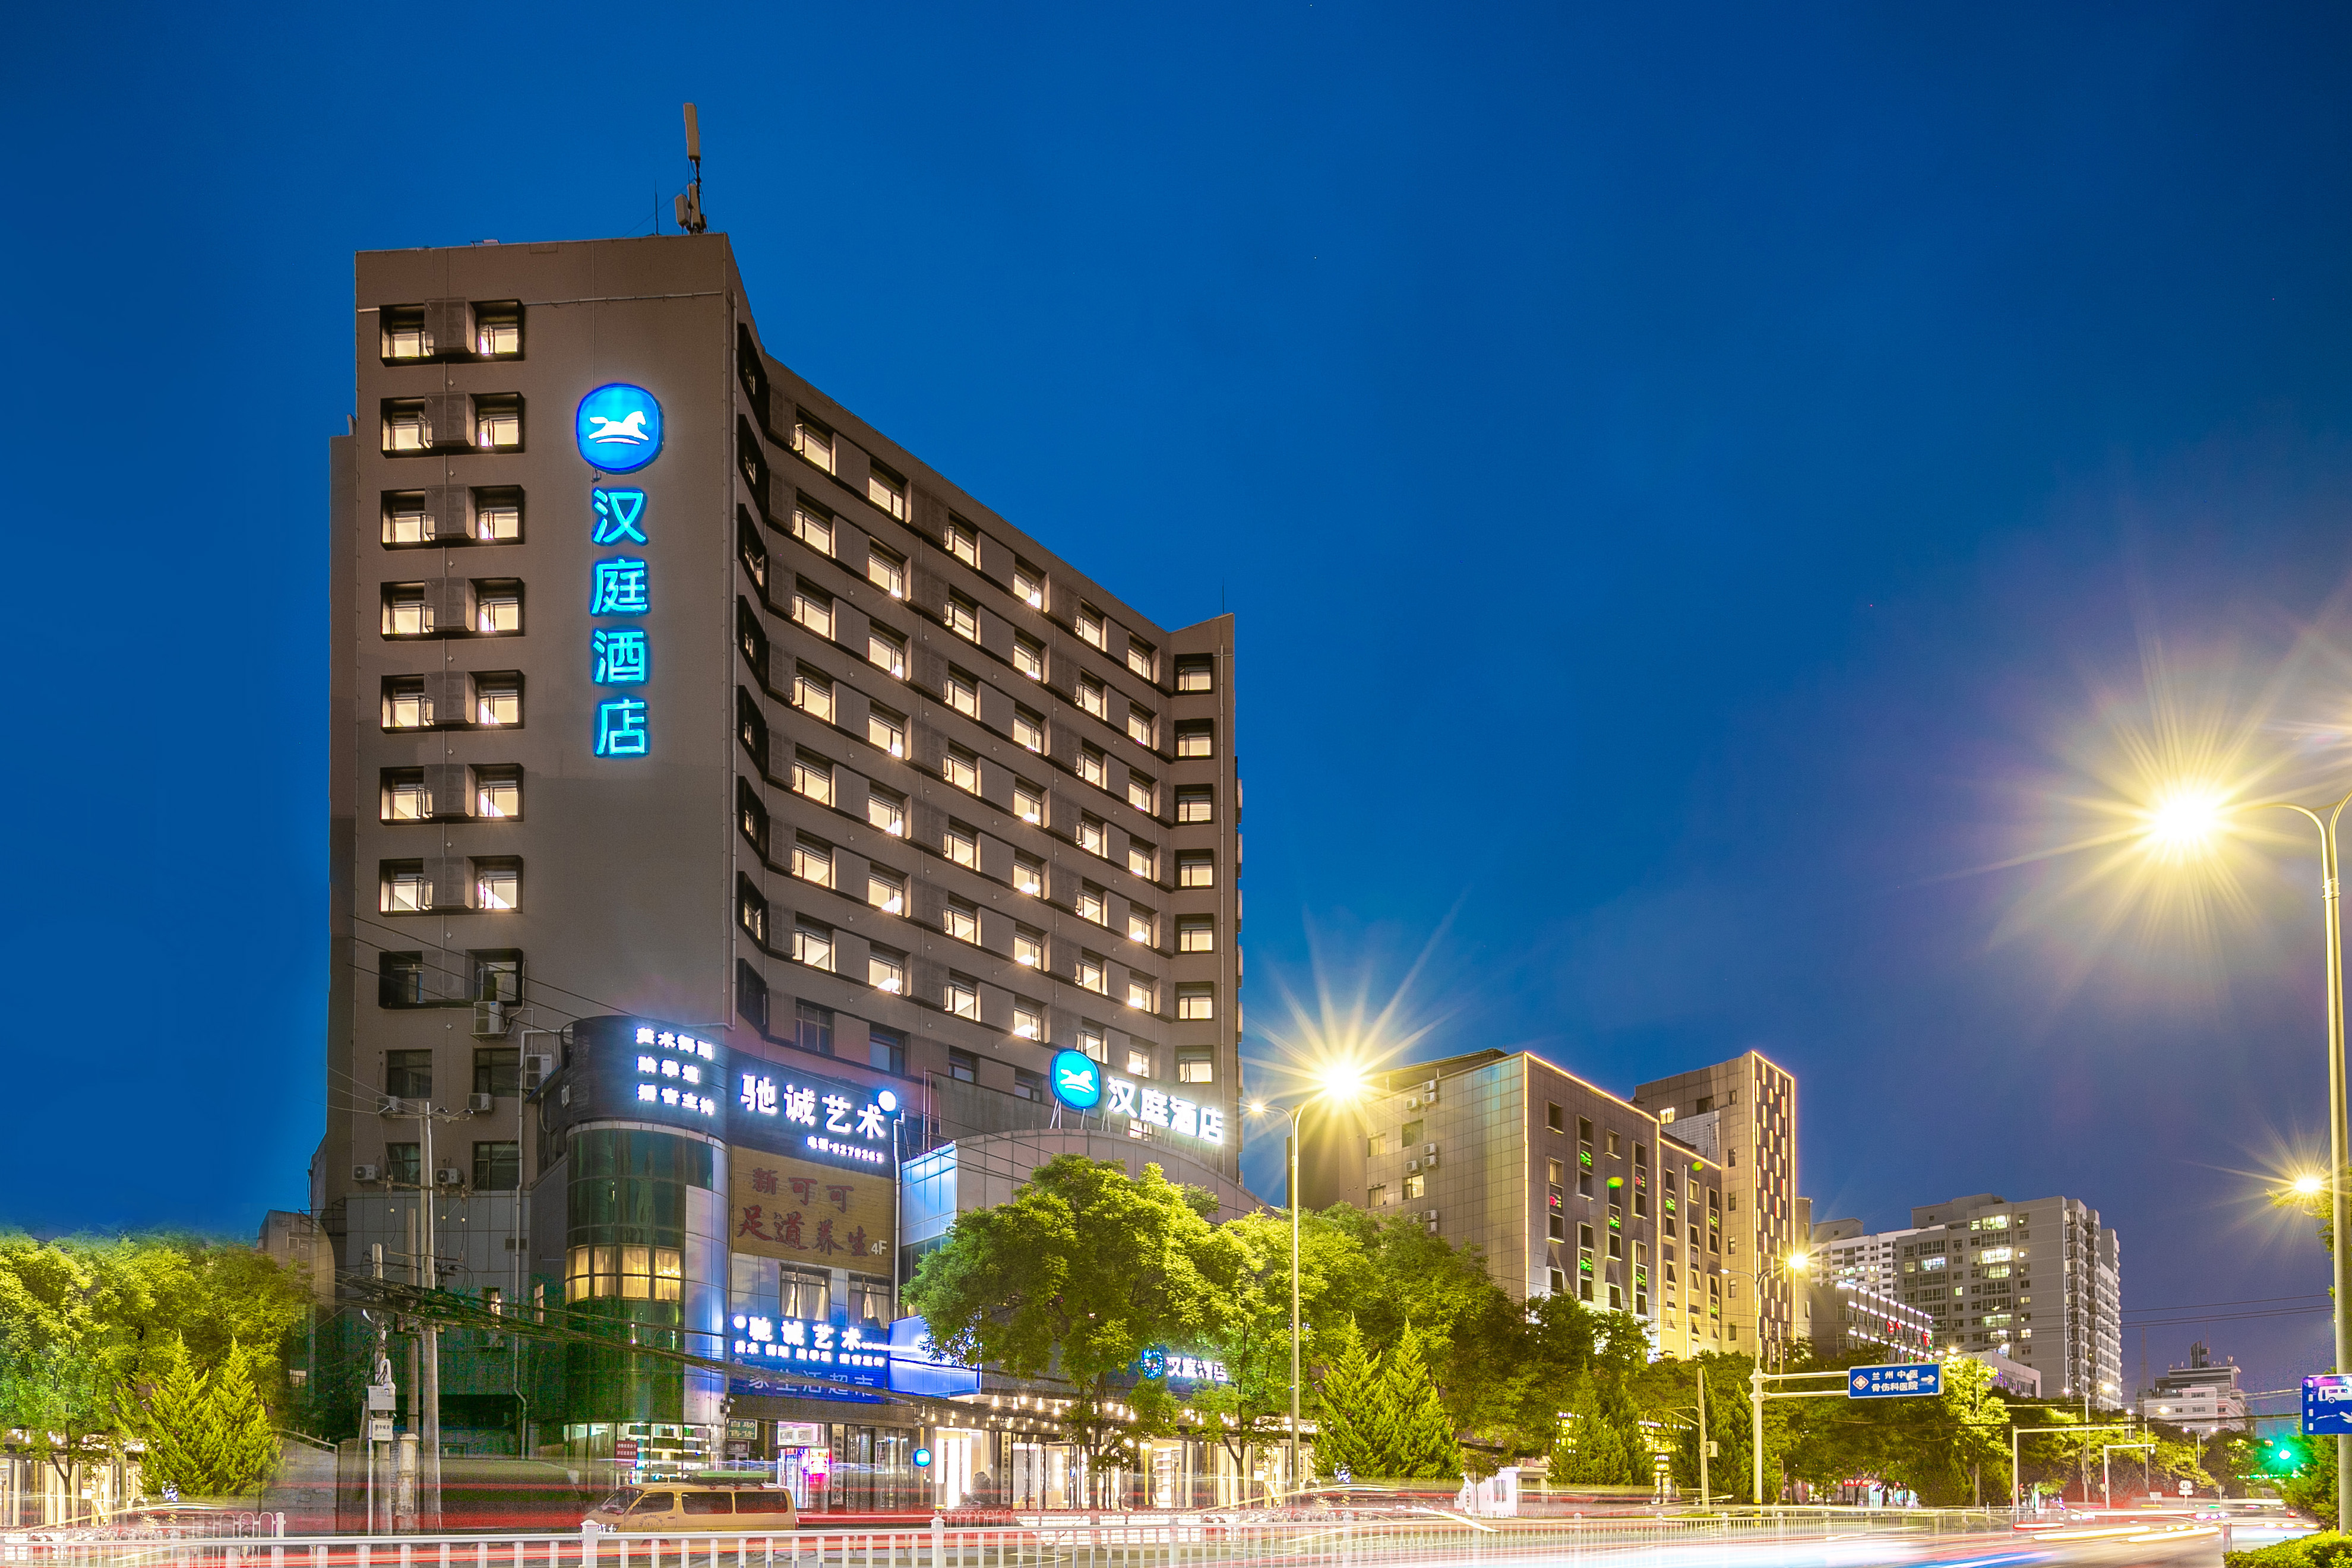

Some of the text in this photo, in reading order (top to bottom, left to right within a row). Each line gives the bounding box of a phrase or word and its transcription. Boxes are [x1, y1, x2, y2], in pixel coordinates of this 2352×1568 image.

[592, 487, 649, 757] 汉庭酒店
[740, 1074, 886, 1139] 驰诚艺术
[1107, 1076, 1224, 1145] 汉庭酒店
[753, 1168, 854, 1213] 新可可
[736, 1205, 887, 1256] 足道养生 4F
[748, 1316, 861, 1351] 驰诚艺术
[1166, 1357, 1228, 1382] 汉庭酒店
[1872, 1370, 1918, 1380] 兰州中医
[1872, 1381, 1918, 1392] 骨伤科医院
